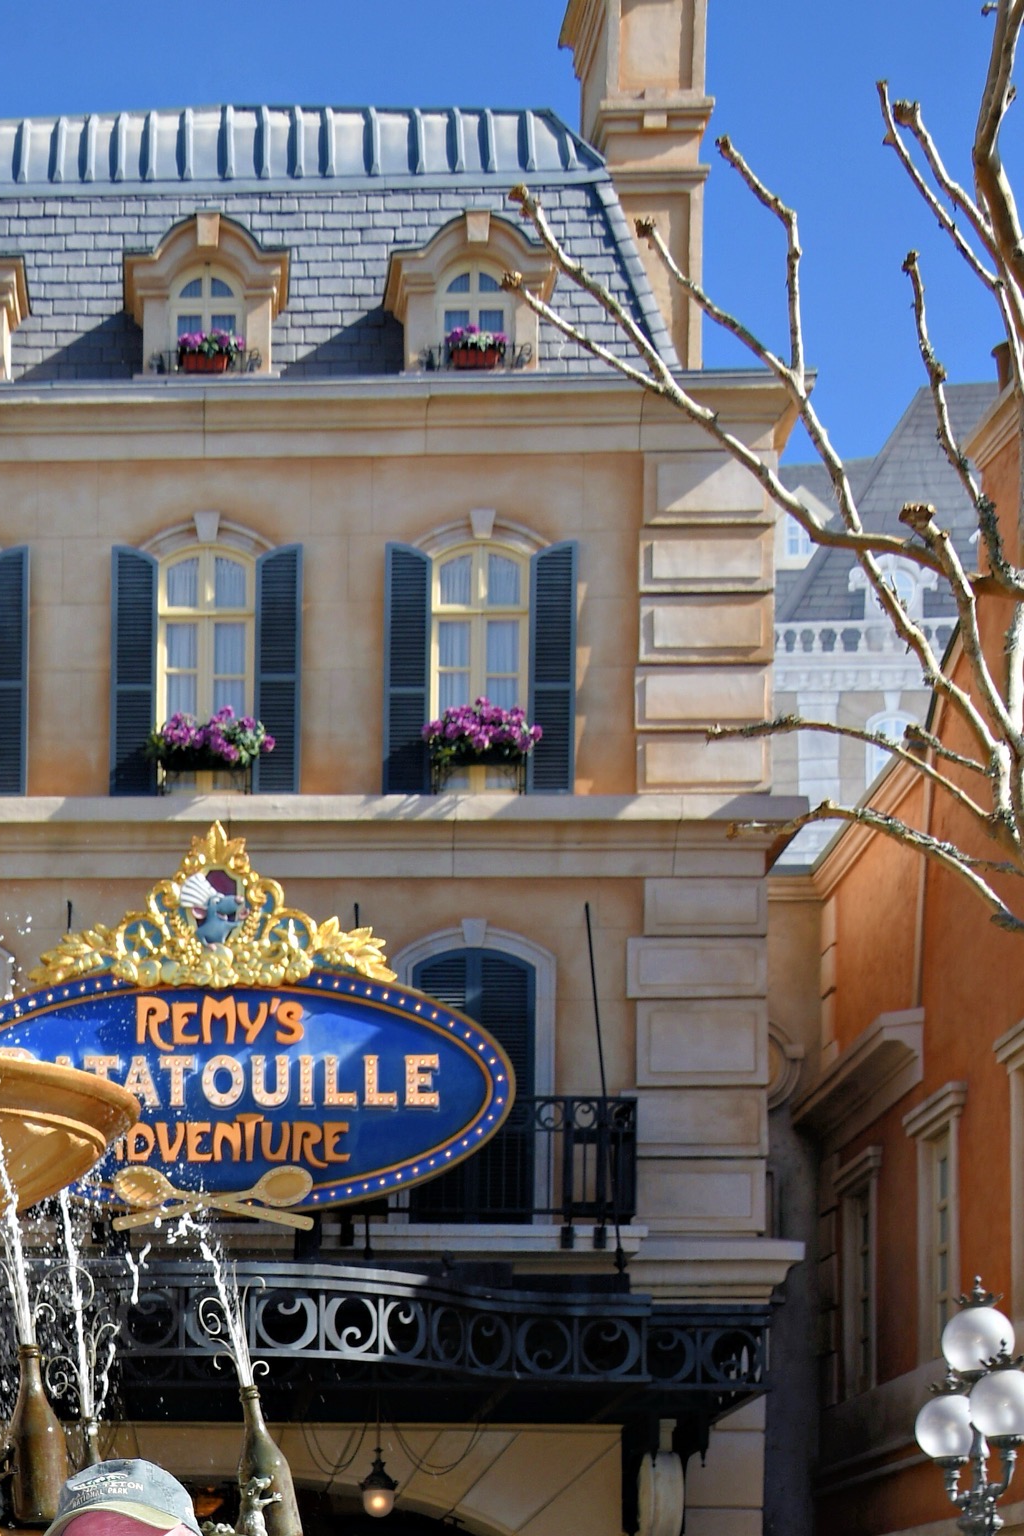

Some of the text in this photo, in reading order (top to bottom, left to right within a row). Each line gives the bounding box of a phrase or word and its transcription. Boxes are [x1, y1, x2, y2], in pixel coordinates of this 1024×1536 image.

[135, 994, 305, 1051] REMY'S
[115, 1113, 352, 1169] DVENTURE
[72, 1487, 128, 1509] NATIONAL PARK
[103, 1481, 144, 1492] TETON
